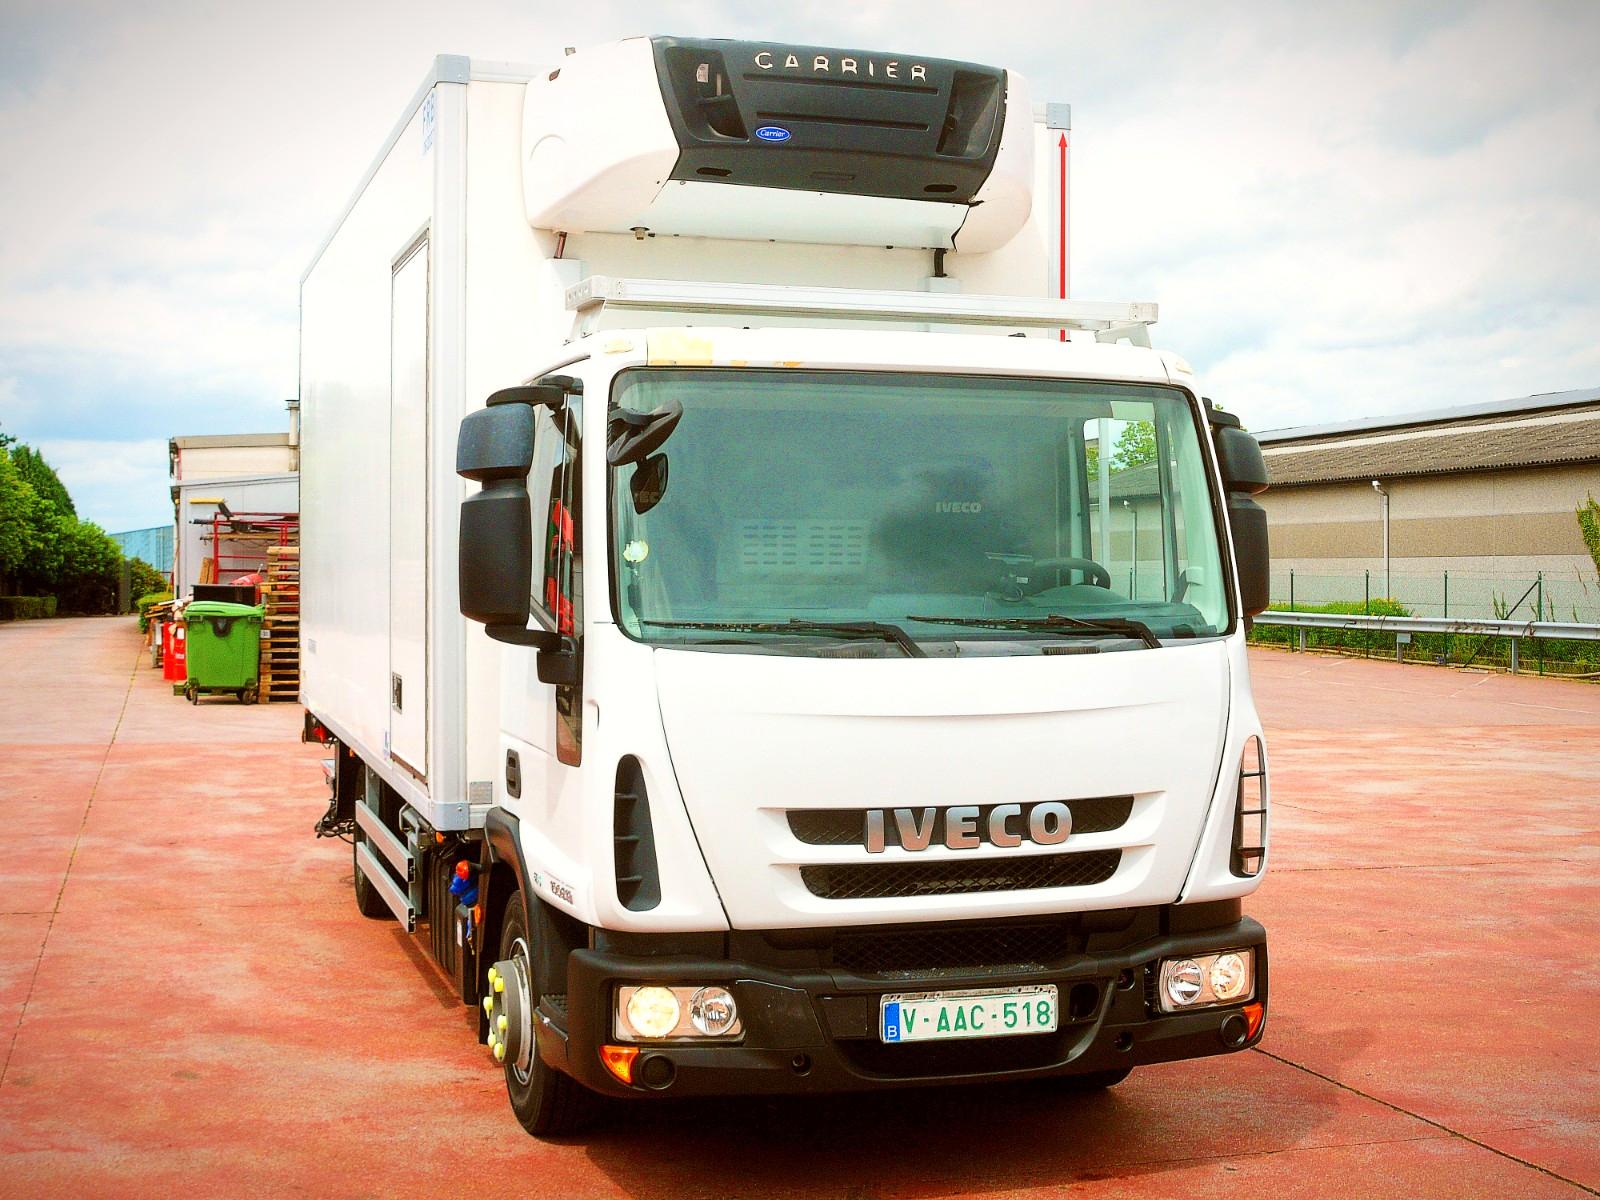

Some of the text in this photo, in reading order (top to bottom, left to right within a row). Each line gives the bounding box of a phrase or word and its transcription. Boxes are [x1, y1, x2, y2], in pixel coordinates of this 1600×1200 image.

[754, 52, 926, 83] CARRIER
[760, 129, 786, 138] Carrier
[935, 500, 982, 514] IVECO
[864, 802, 1072, 853] IVECO
[887, 1025, 898, 1038] B
